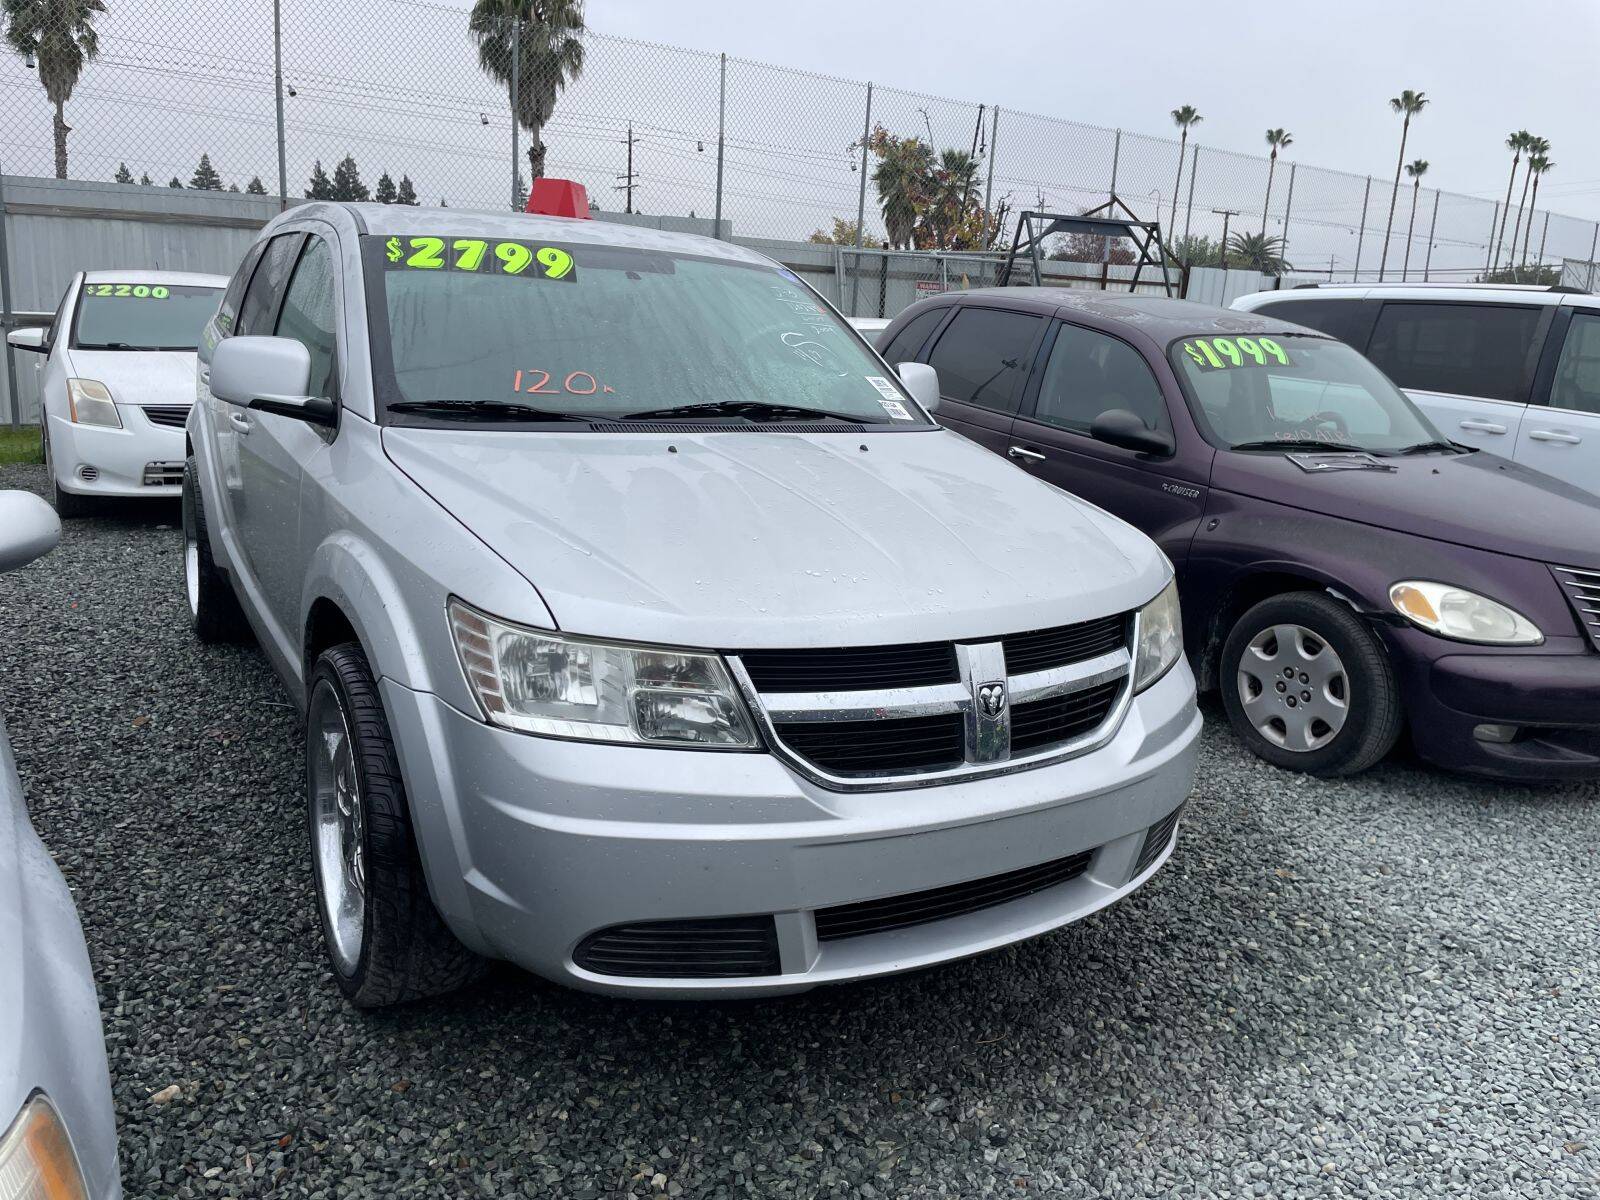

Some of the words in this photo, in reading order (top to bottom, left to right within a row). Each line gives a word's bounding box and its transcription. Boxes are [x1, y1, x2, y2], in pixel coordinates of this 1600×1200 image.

[386, 237, 573, 279] $2799
[87, 285, 169, 299] $2200
[1184, 338, 1289, 368] $1999
[1168, 485, 1200, 498] CRUISER
